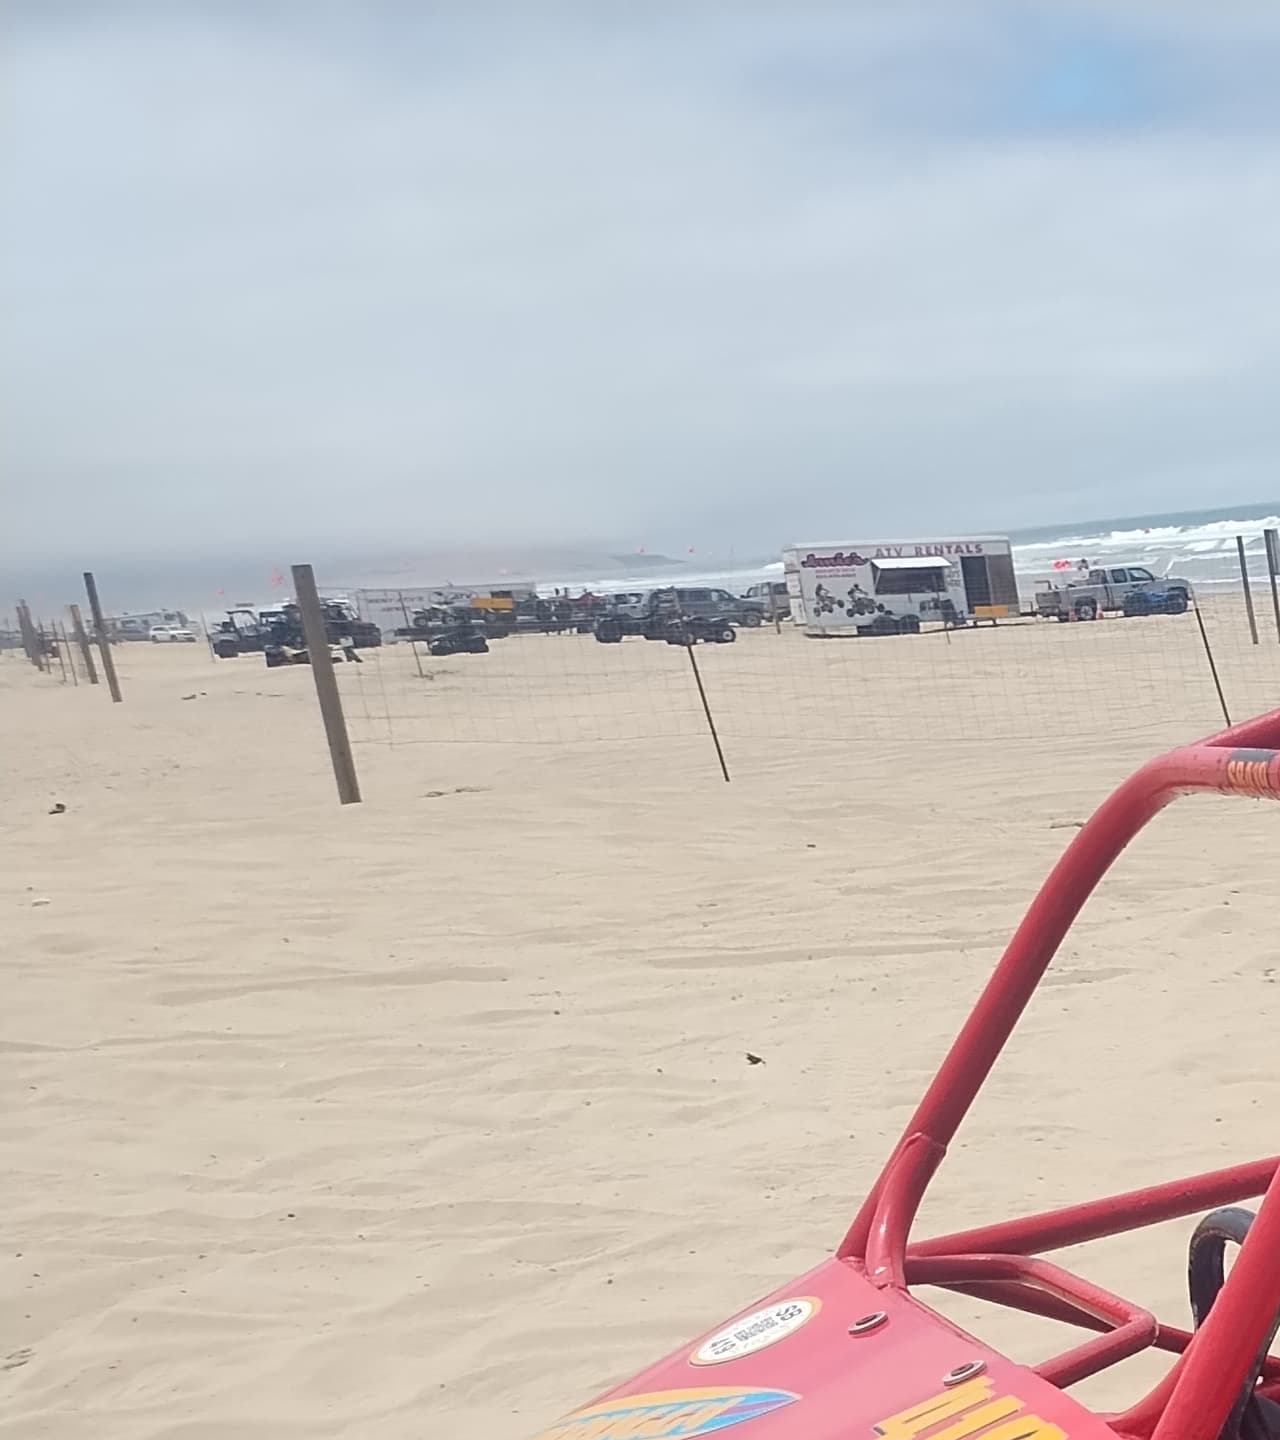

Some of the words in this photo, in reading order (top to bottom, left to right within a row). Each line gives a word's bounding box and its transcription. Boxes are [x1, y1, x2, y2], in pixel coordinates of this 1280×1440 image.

[875, 547, 903, 557] ATV
[914, 544, 983, 557] RENTALS
[775, 1304, 803, 1322] SB
